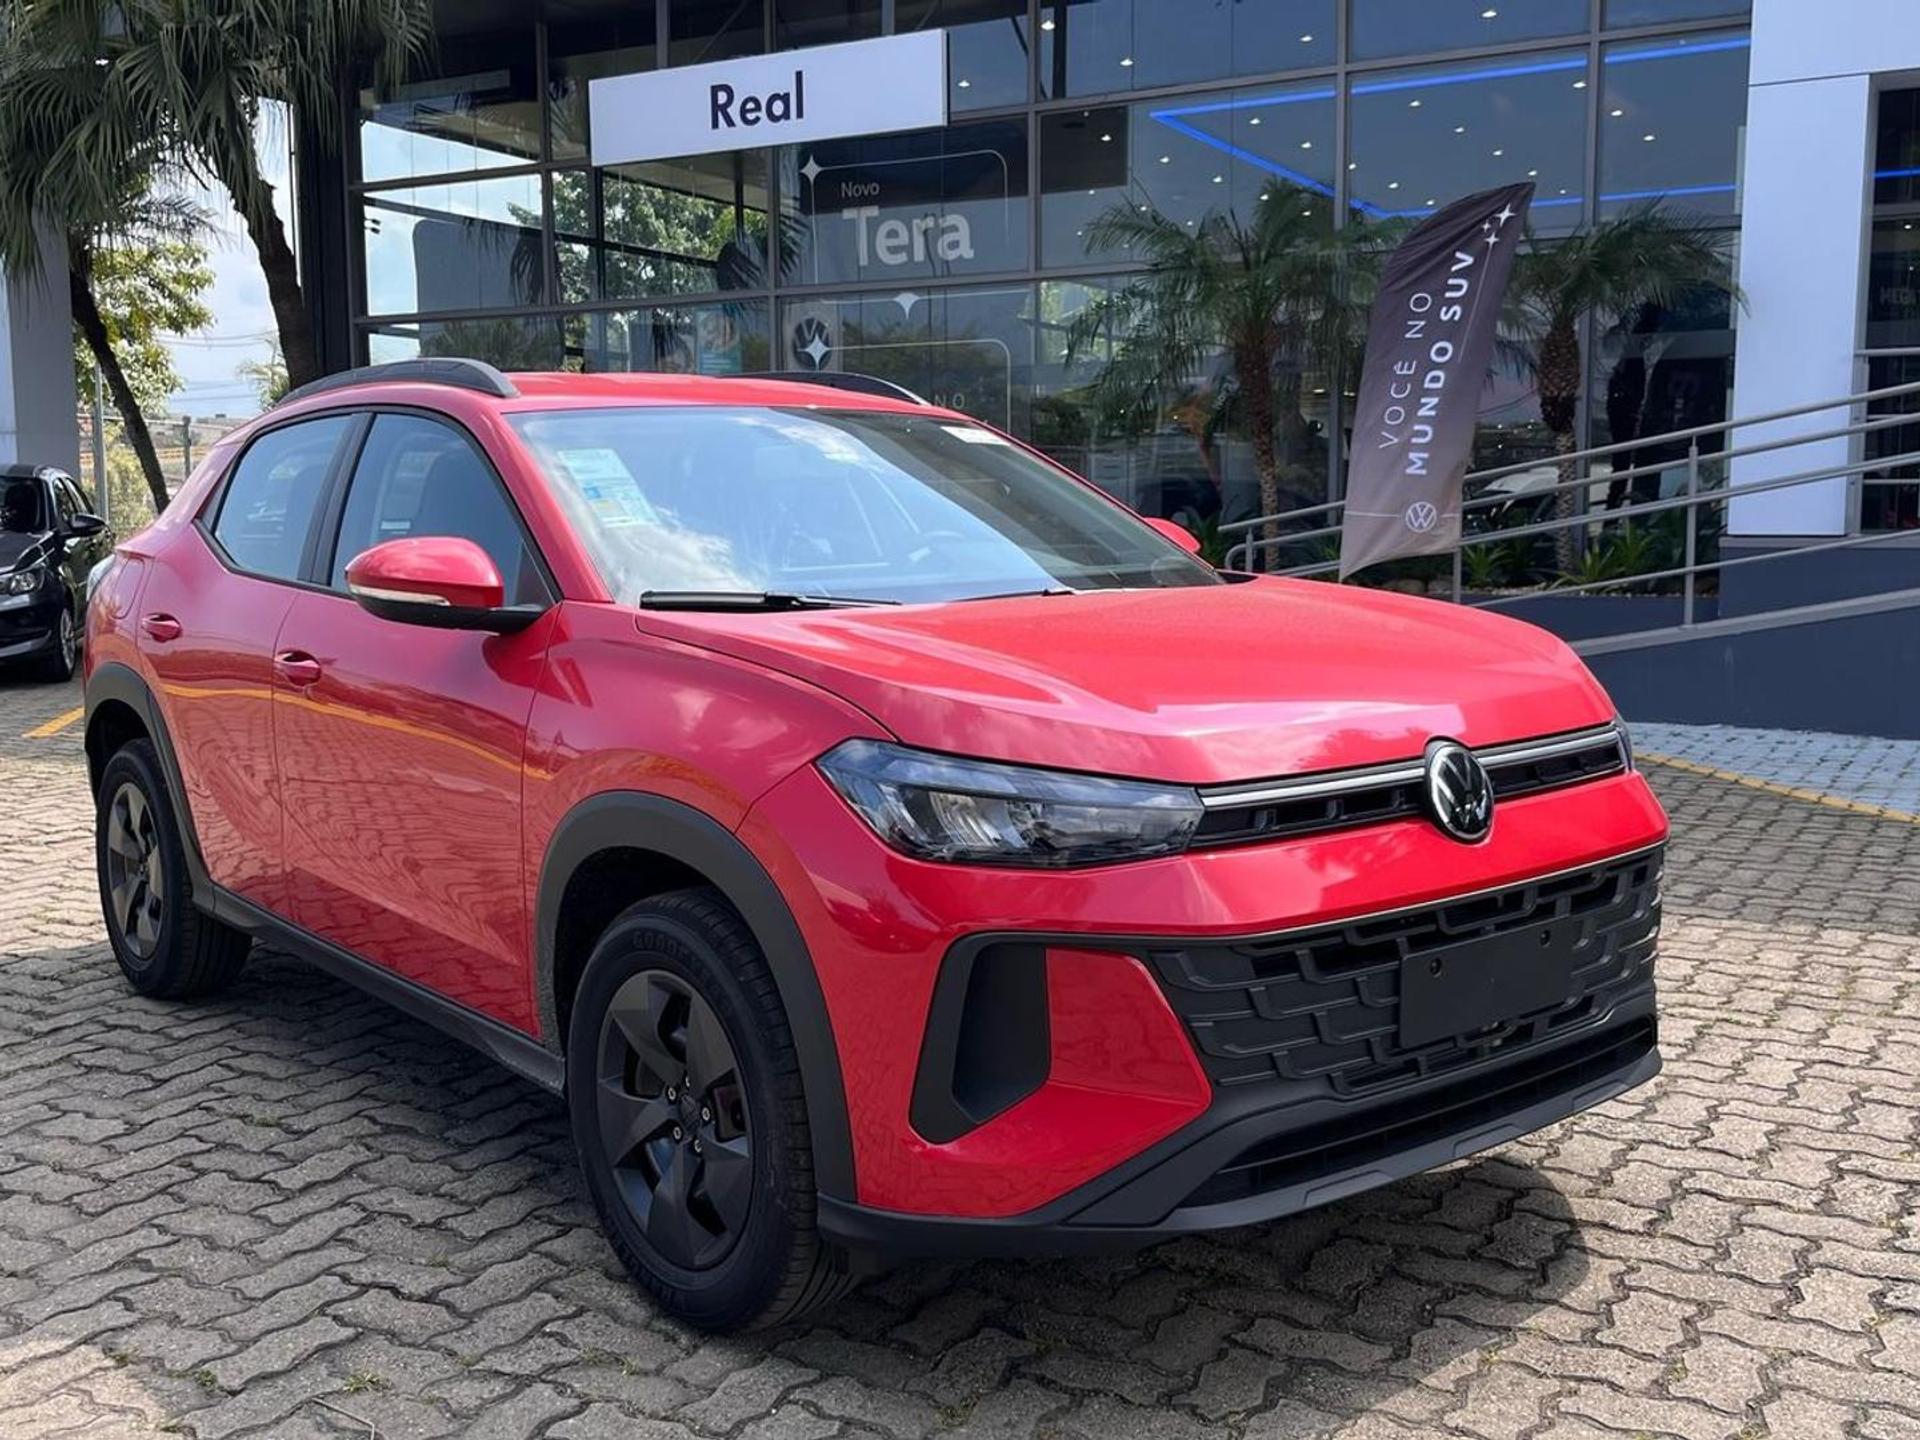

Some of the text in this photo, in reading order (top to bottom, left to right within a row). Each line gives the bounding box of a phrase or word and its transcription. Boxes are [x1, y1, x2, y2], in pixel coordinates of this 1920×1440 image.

[709, 70, 804, 130] Real
[841, 181, 880, 197] Novo
[842, 205, 975, 267] Tera
[1379, 293, 1432, 450] VOCÊ NO
[1405, 251, 1475, 475] MUNDO SUV
